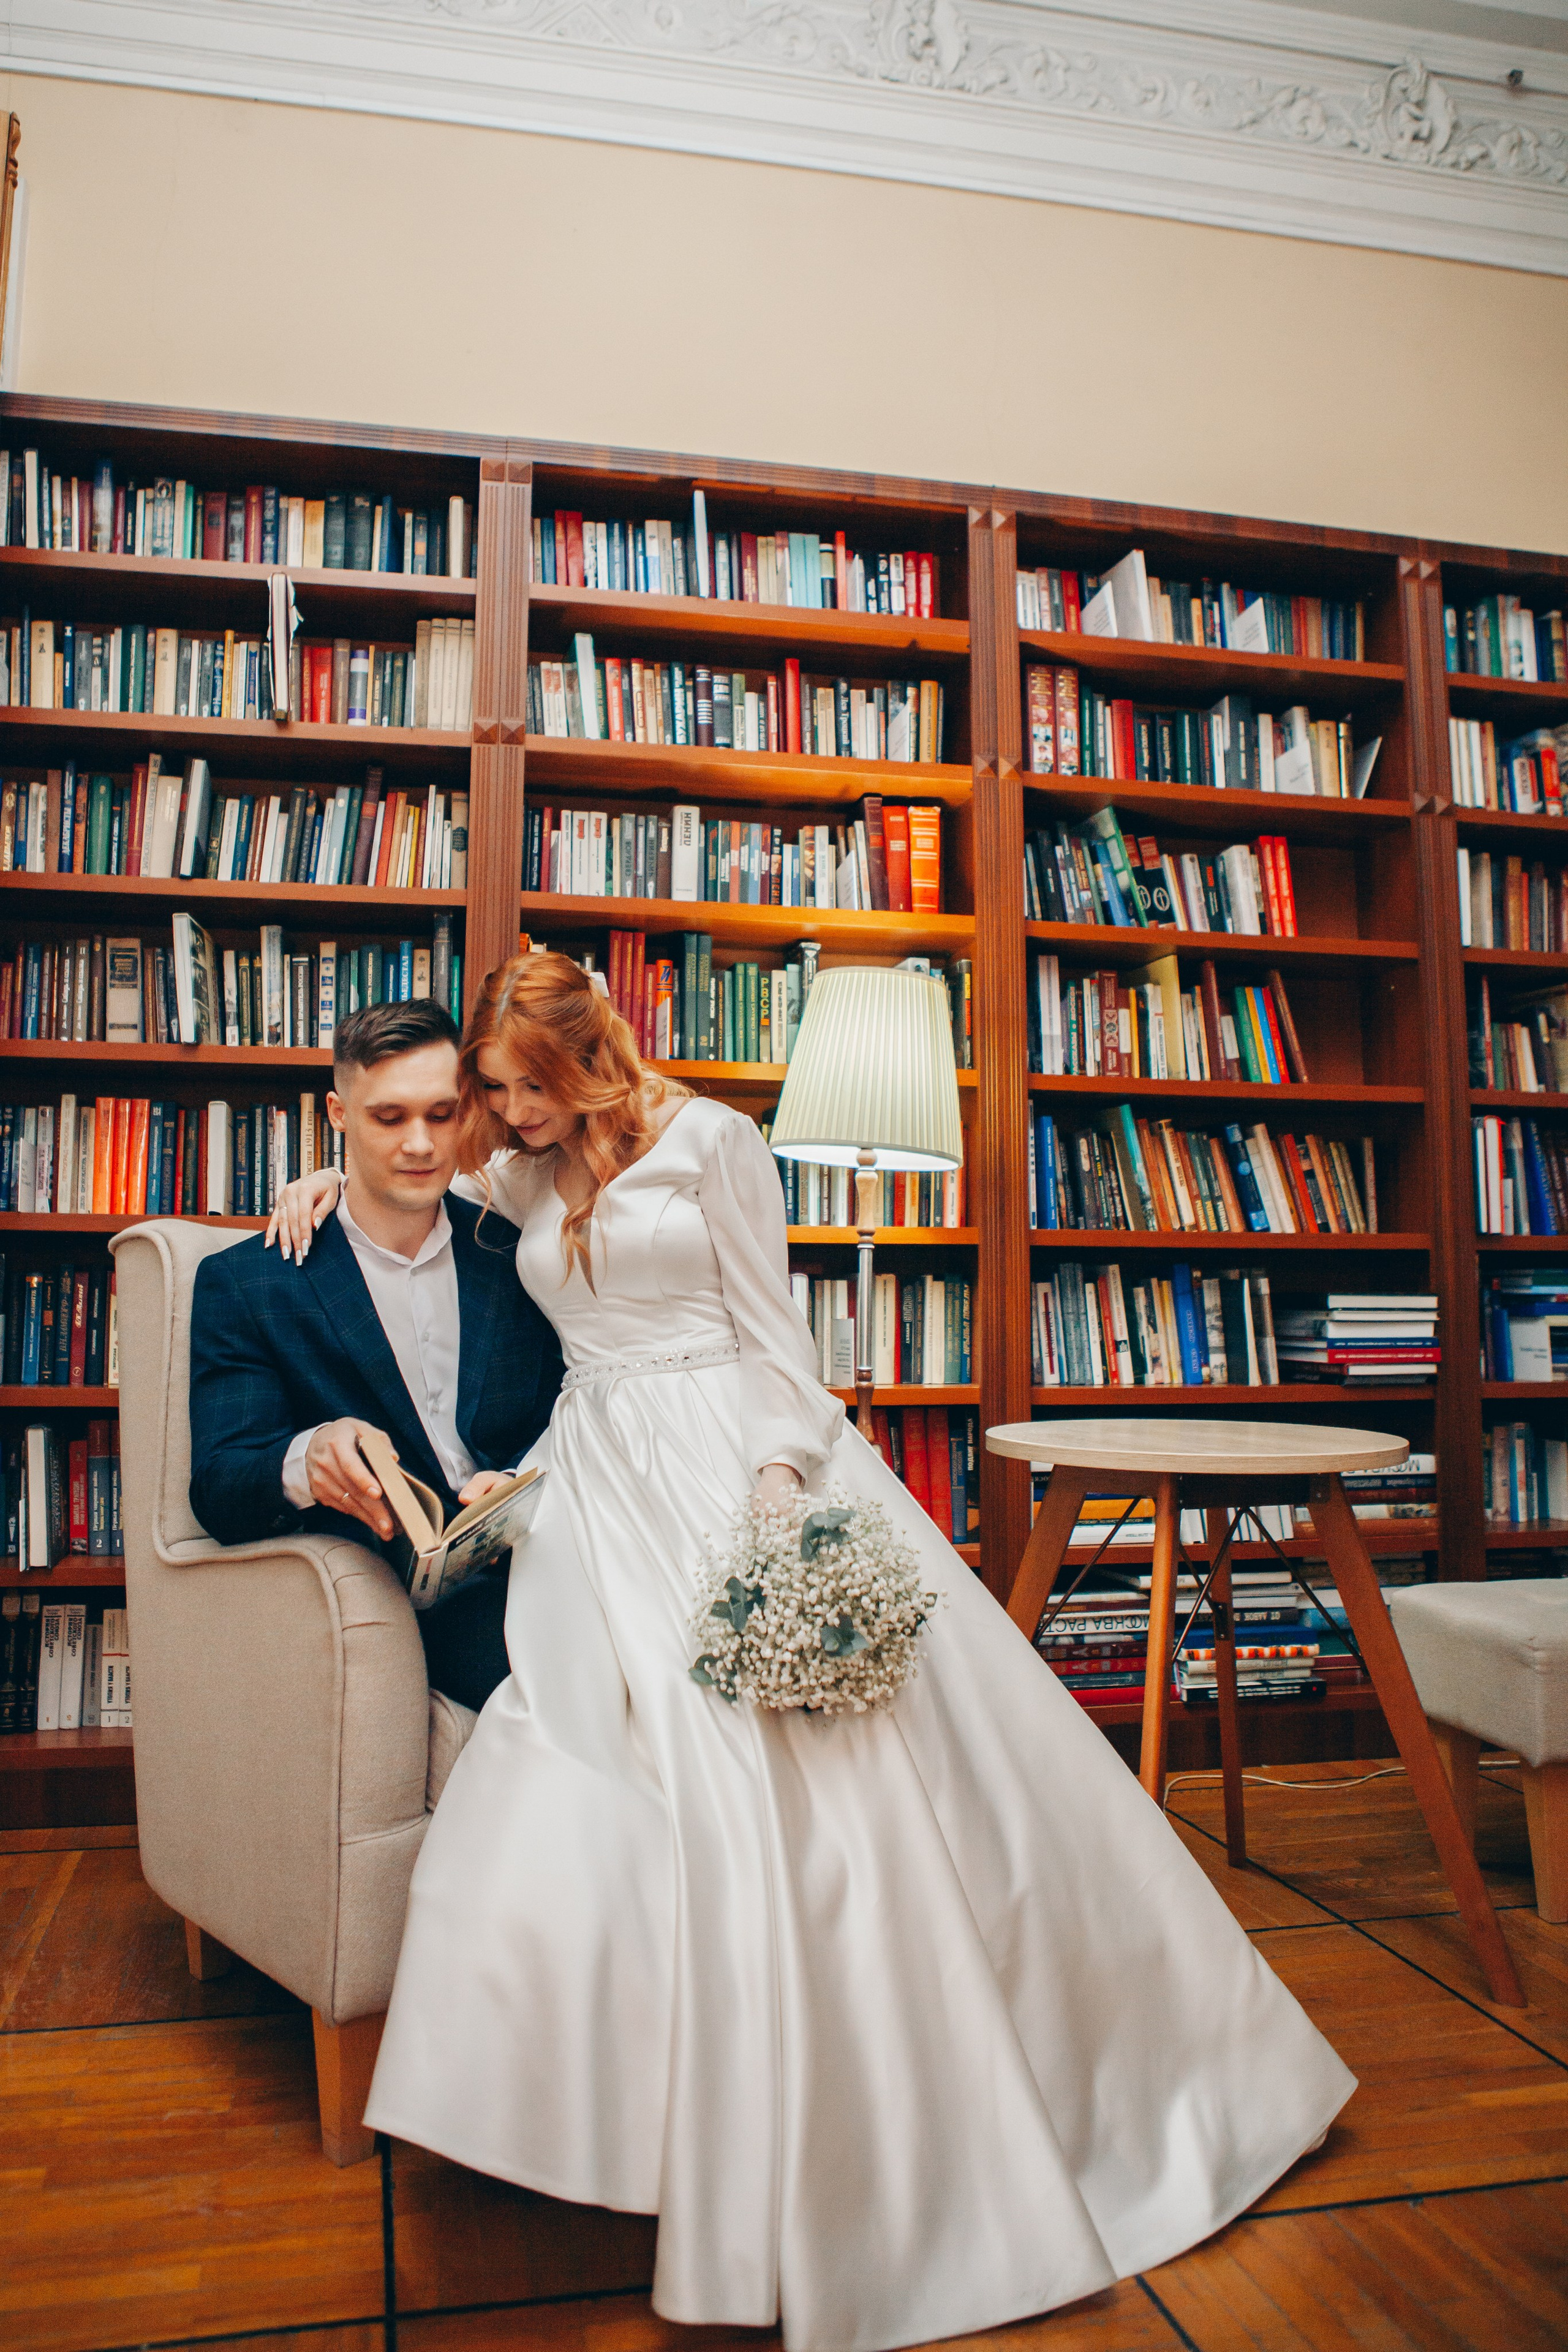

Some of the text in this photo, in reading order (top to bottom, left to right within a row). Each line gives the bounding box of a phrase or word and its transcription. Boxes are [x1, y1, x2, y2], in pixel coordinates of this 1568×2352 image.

[674, 687, 685, 744] БУХАРИН
[62, 807, 72, 855] ДЕКАБРИСТЫ
[96, 1539, 102, 1548] 2
[116, 1539, 120, 1548] 1
